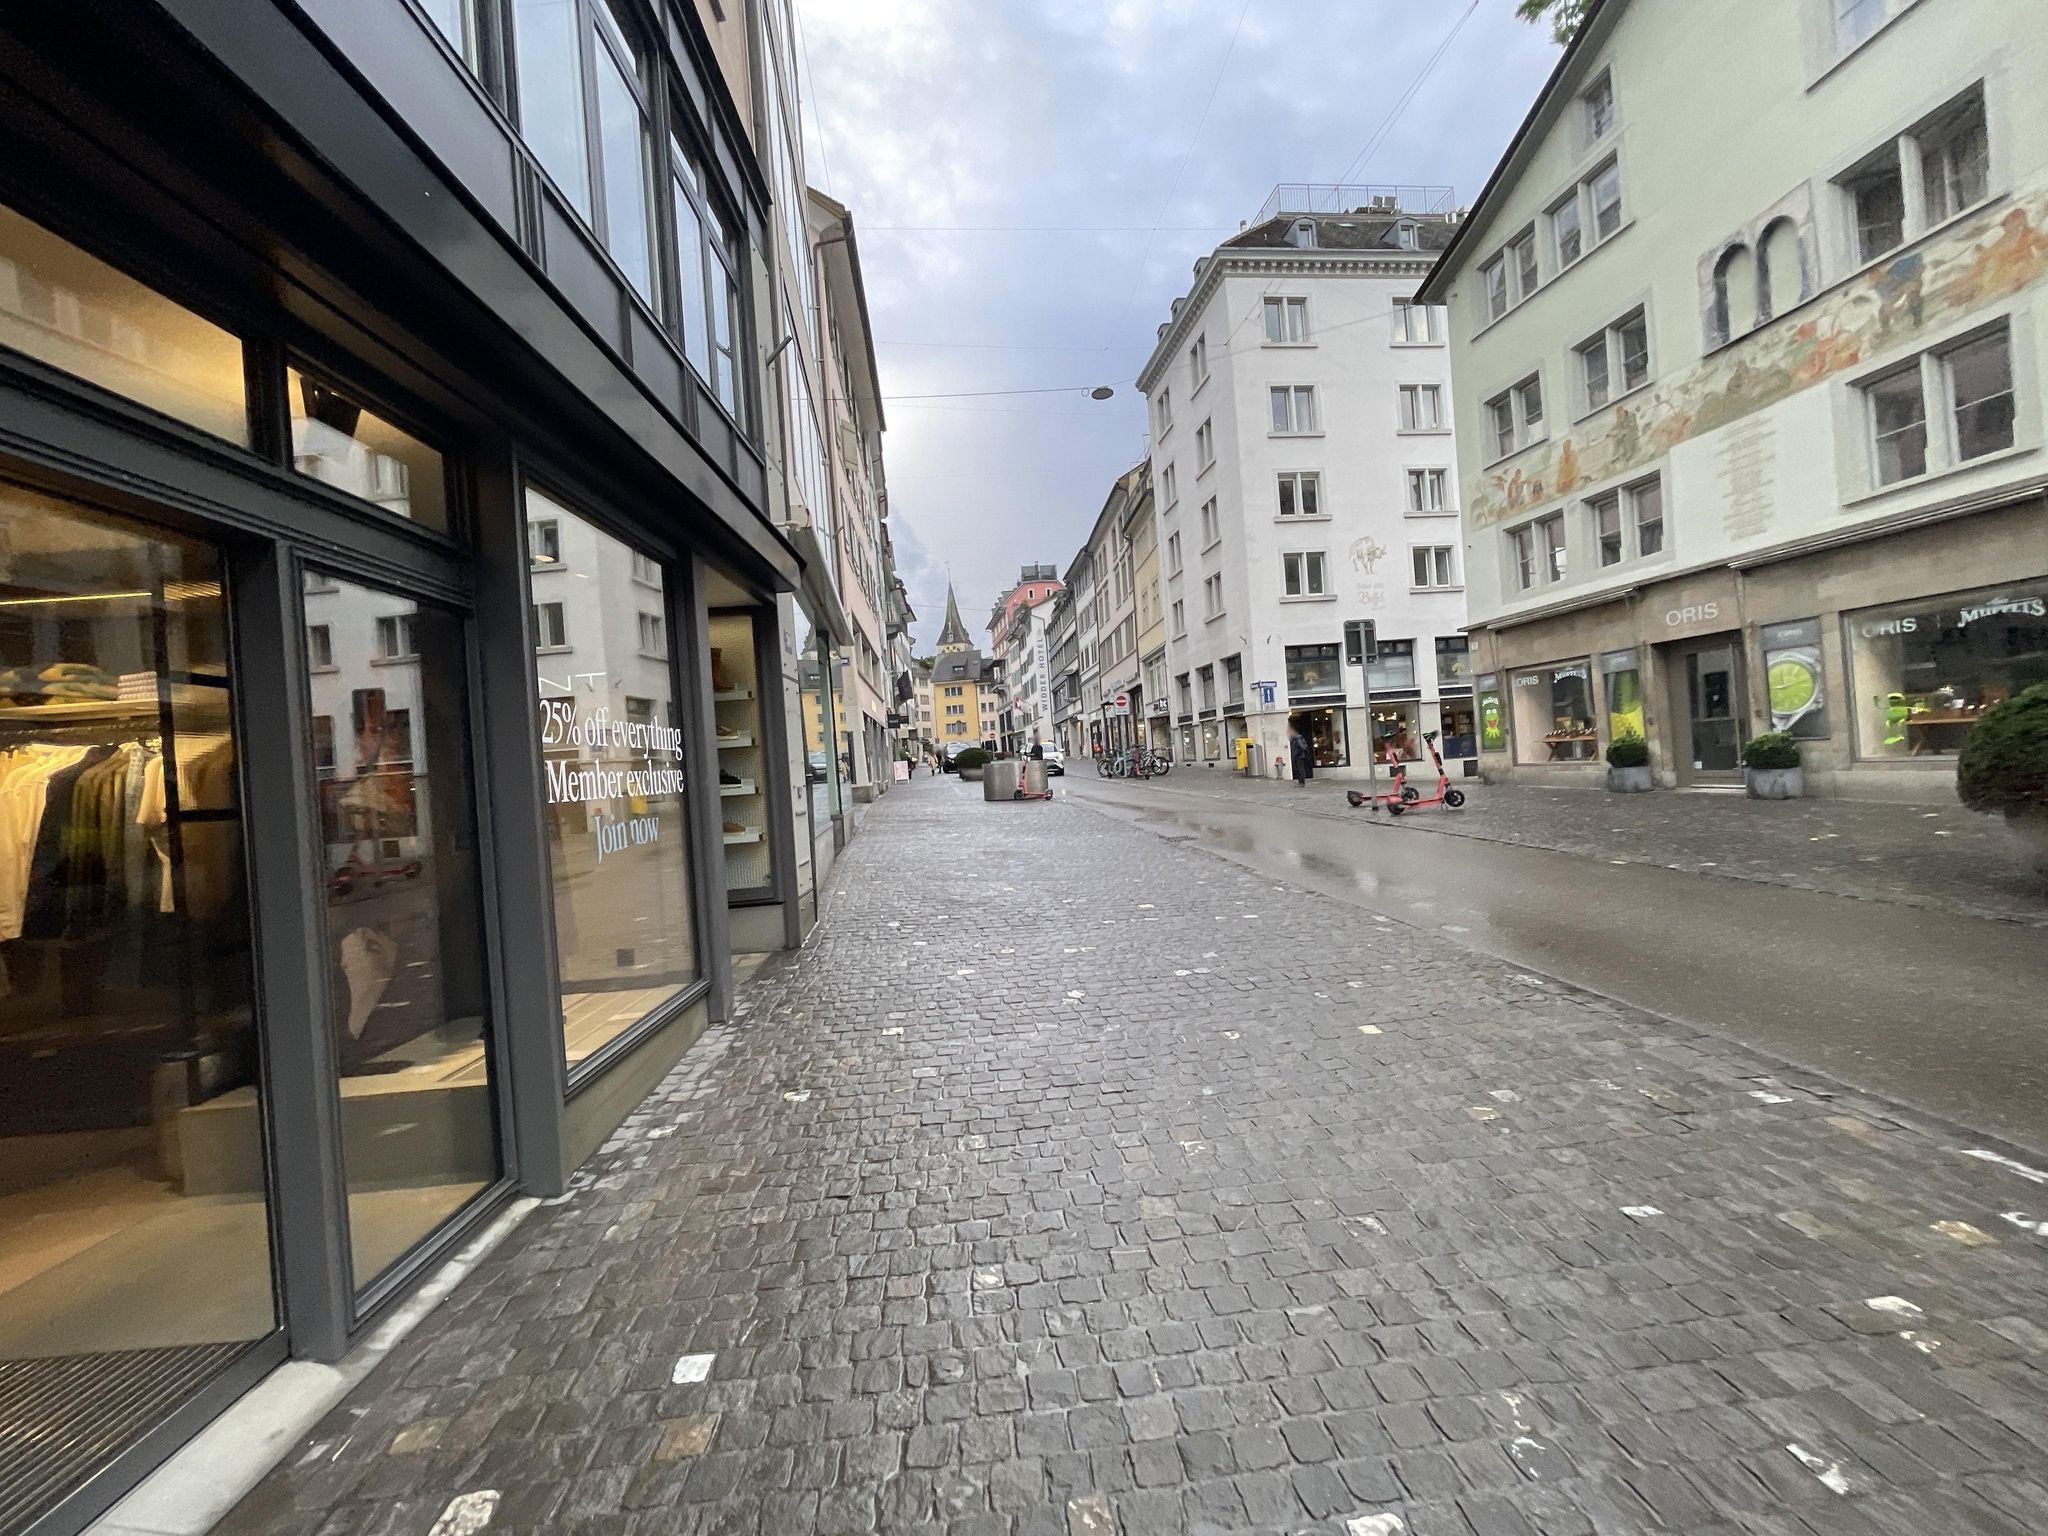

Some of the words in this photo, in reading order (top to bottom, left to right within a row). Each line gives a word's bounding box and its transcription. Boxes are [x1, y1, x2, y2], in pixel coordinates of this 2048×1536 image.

[1665, 602, 1719, 627] ORIS
[1037, 637, 1046, 669] HOTEL
[1040, 674, 1049, 712] WIDDER
[1516, 675, 1540, 688] ORIS
[540, 699, 581, 746] 25%
[584, 706, 609, 747] off
[612, 716, 683, 761] everything
[546, 759, 624, 804] Member
[626, 759, 684, 797] exclusive
[594, 813, 627, 865] Join
[630, 815, 659, 846] now
